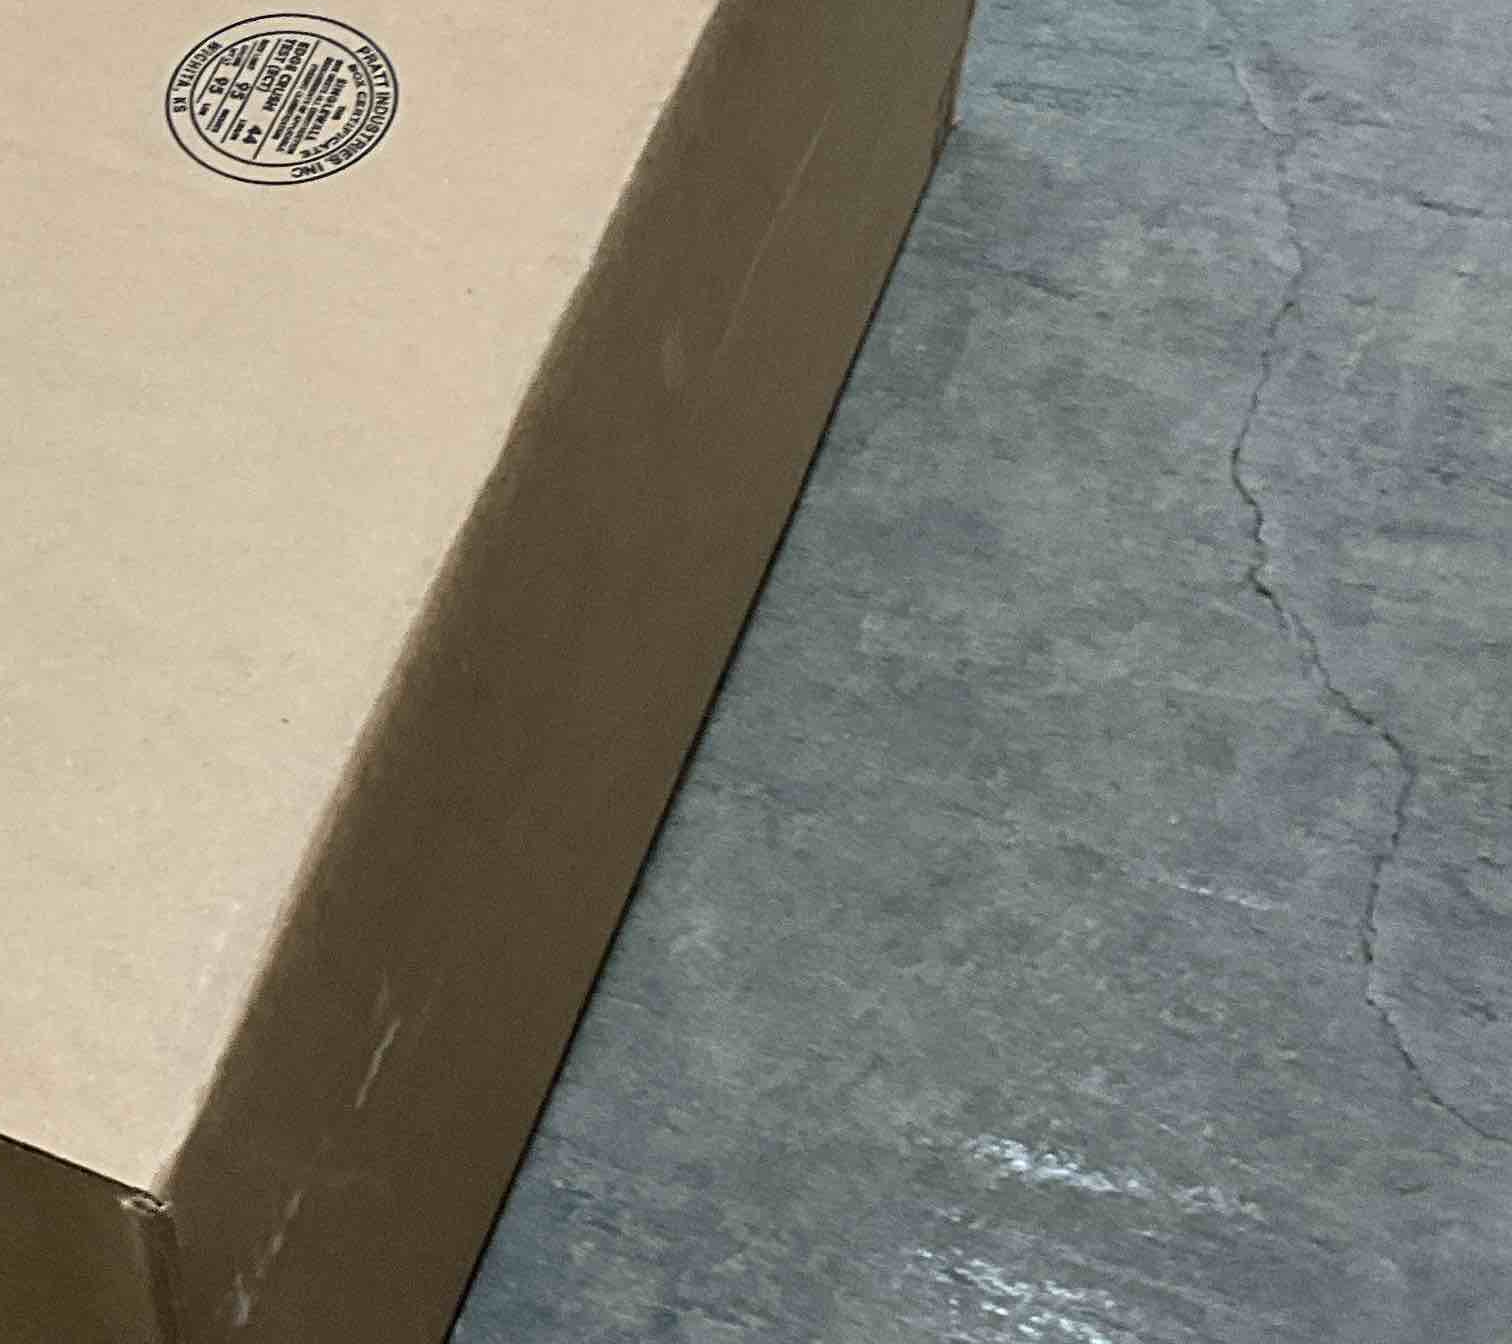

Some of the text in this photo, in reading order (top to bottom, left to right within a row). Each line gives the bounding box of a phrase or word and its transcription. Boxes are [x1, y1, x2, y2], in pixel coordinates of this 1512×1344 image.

[273, 39, 298, 64] TEST
[285, 41, 311, 72] EDGE
[356, 45, 389, 88] PRATT
[256, 64, 282, 93] (ECT)
[262, 73, 292, 112] CRUSH
[299, 91, 368, 159] CERTIFICATE
[324, 91, 390, 166] INDUSTRIES
[290, 160, 324, 179] INC
